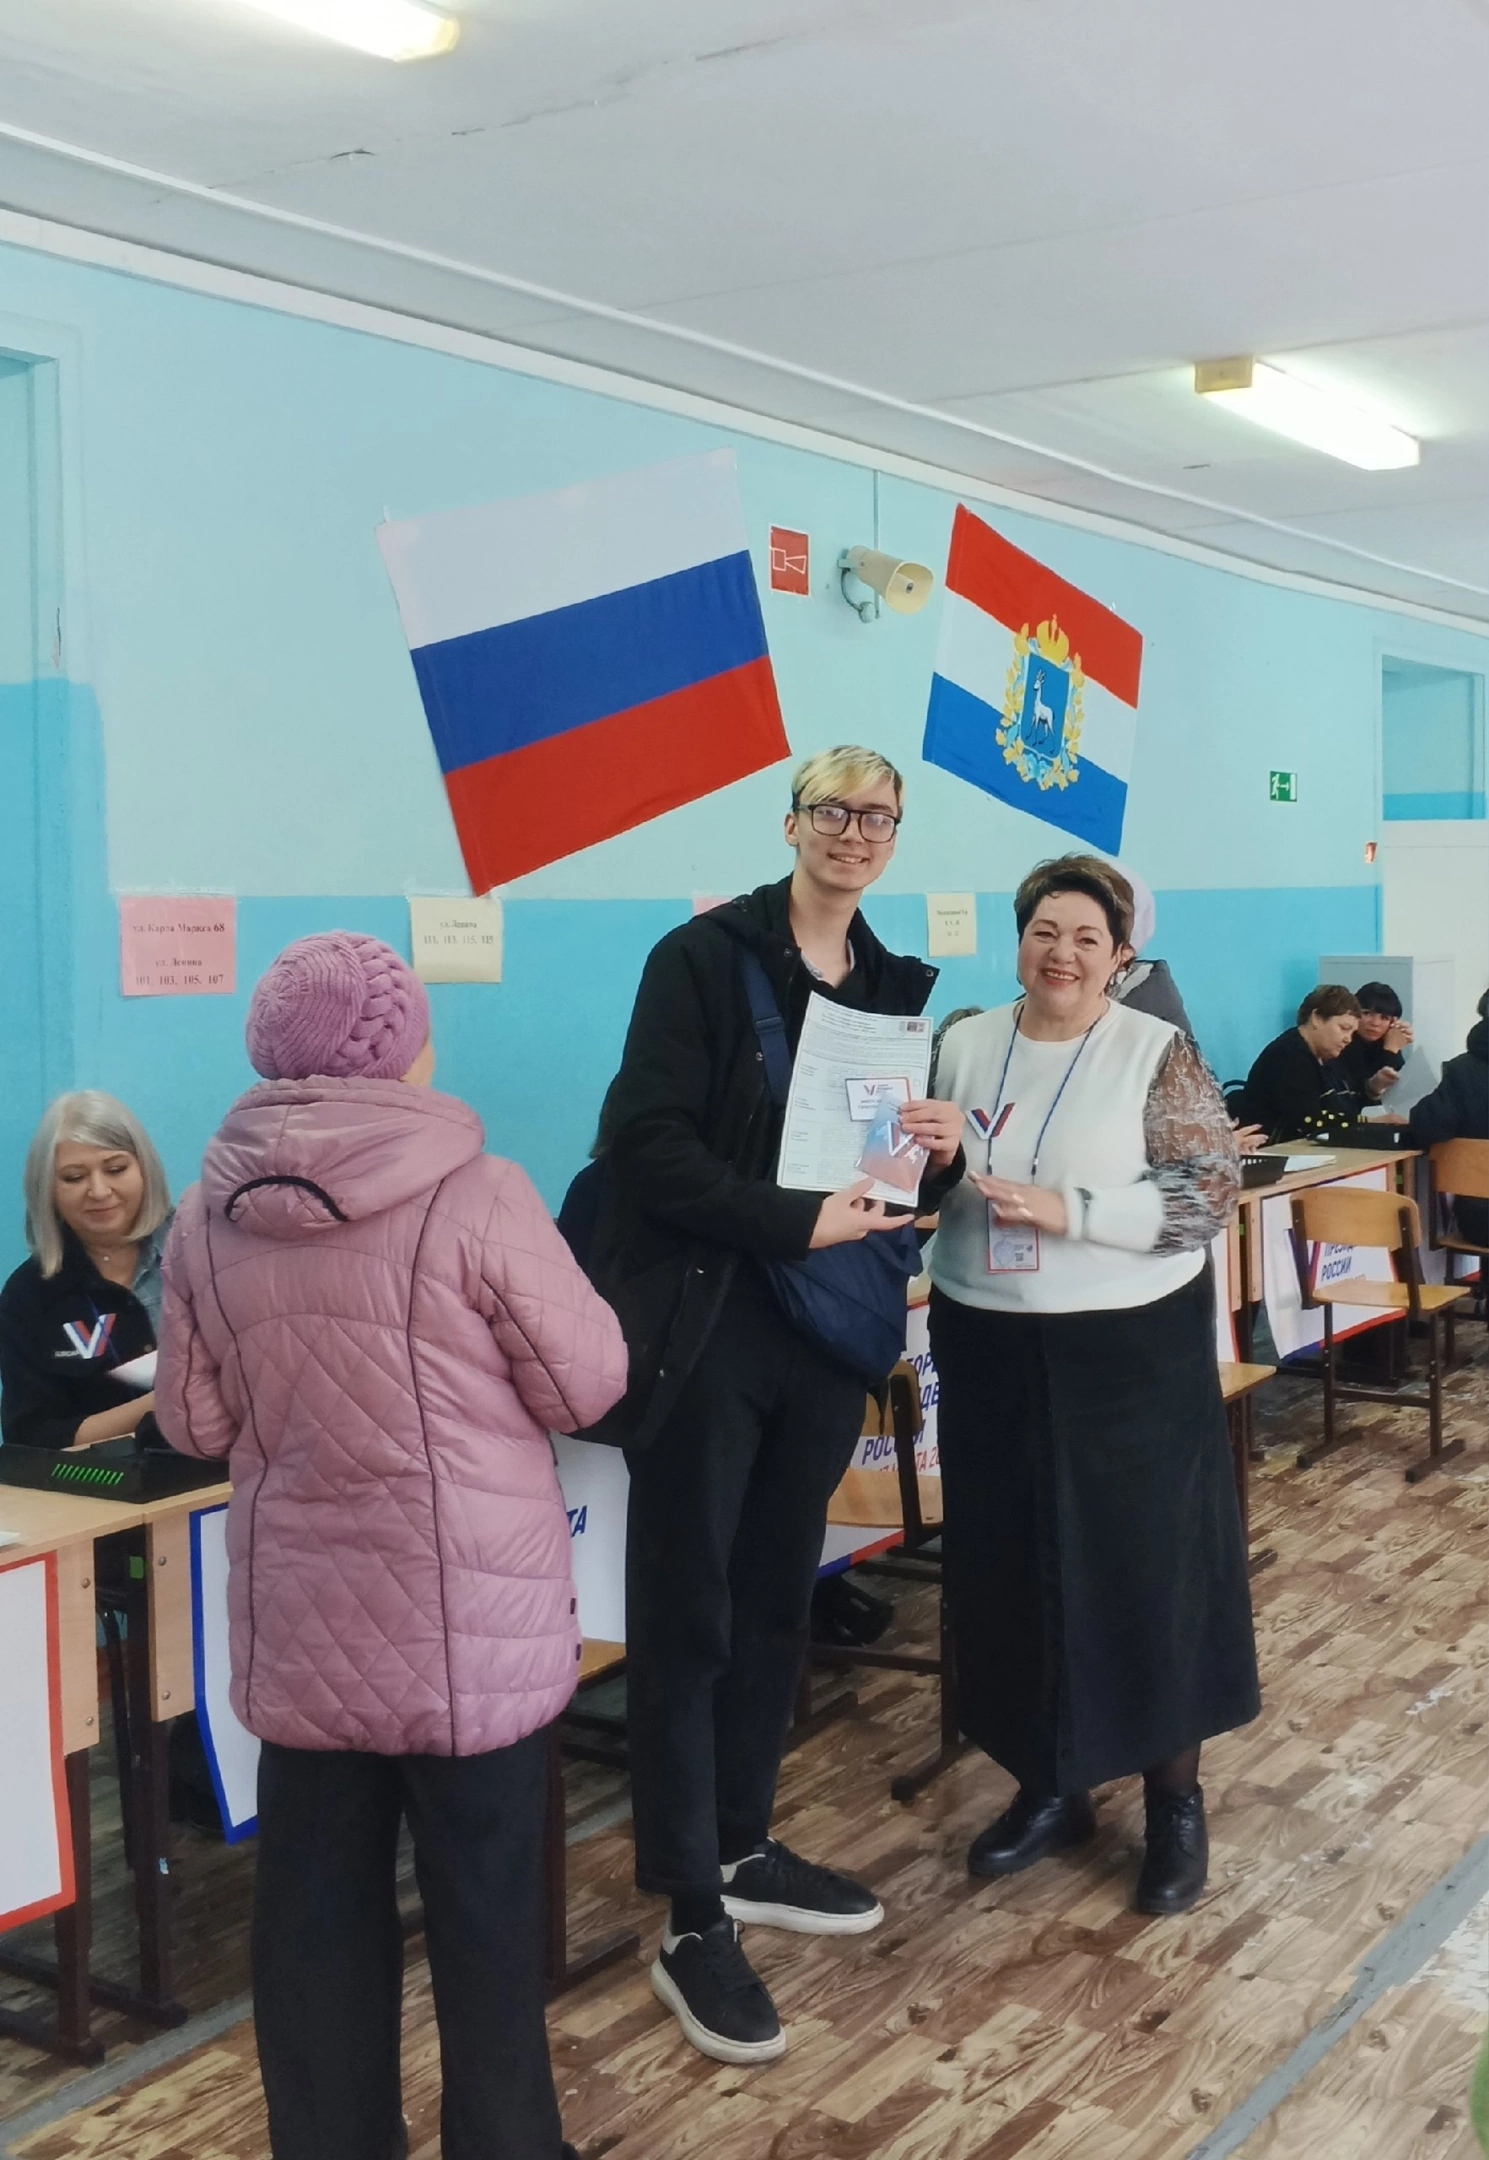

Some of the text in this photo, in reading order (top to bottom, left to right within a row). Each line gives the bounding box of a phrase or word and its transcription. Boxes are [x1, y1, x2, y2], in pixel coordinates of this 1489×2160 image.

[213, 923, 226, 933] 68
[170, 957, 203, 967] Ленина
[208, 973, 225, 985] 107
[1321, 1256, 1353, 1282] РОССИИ
